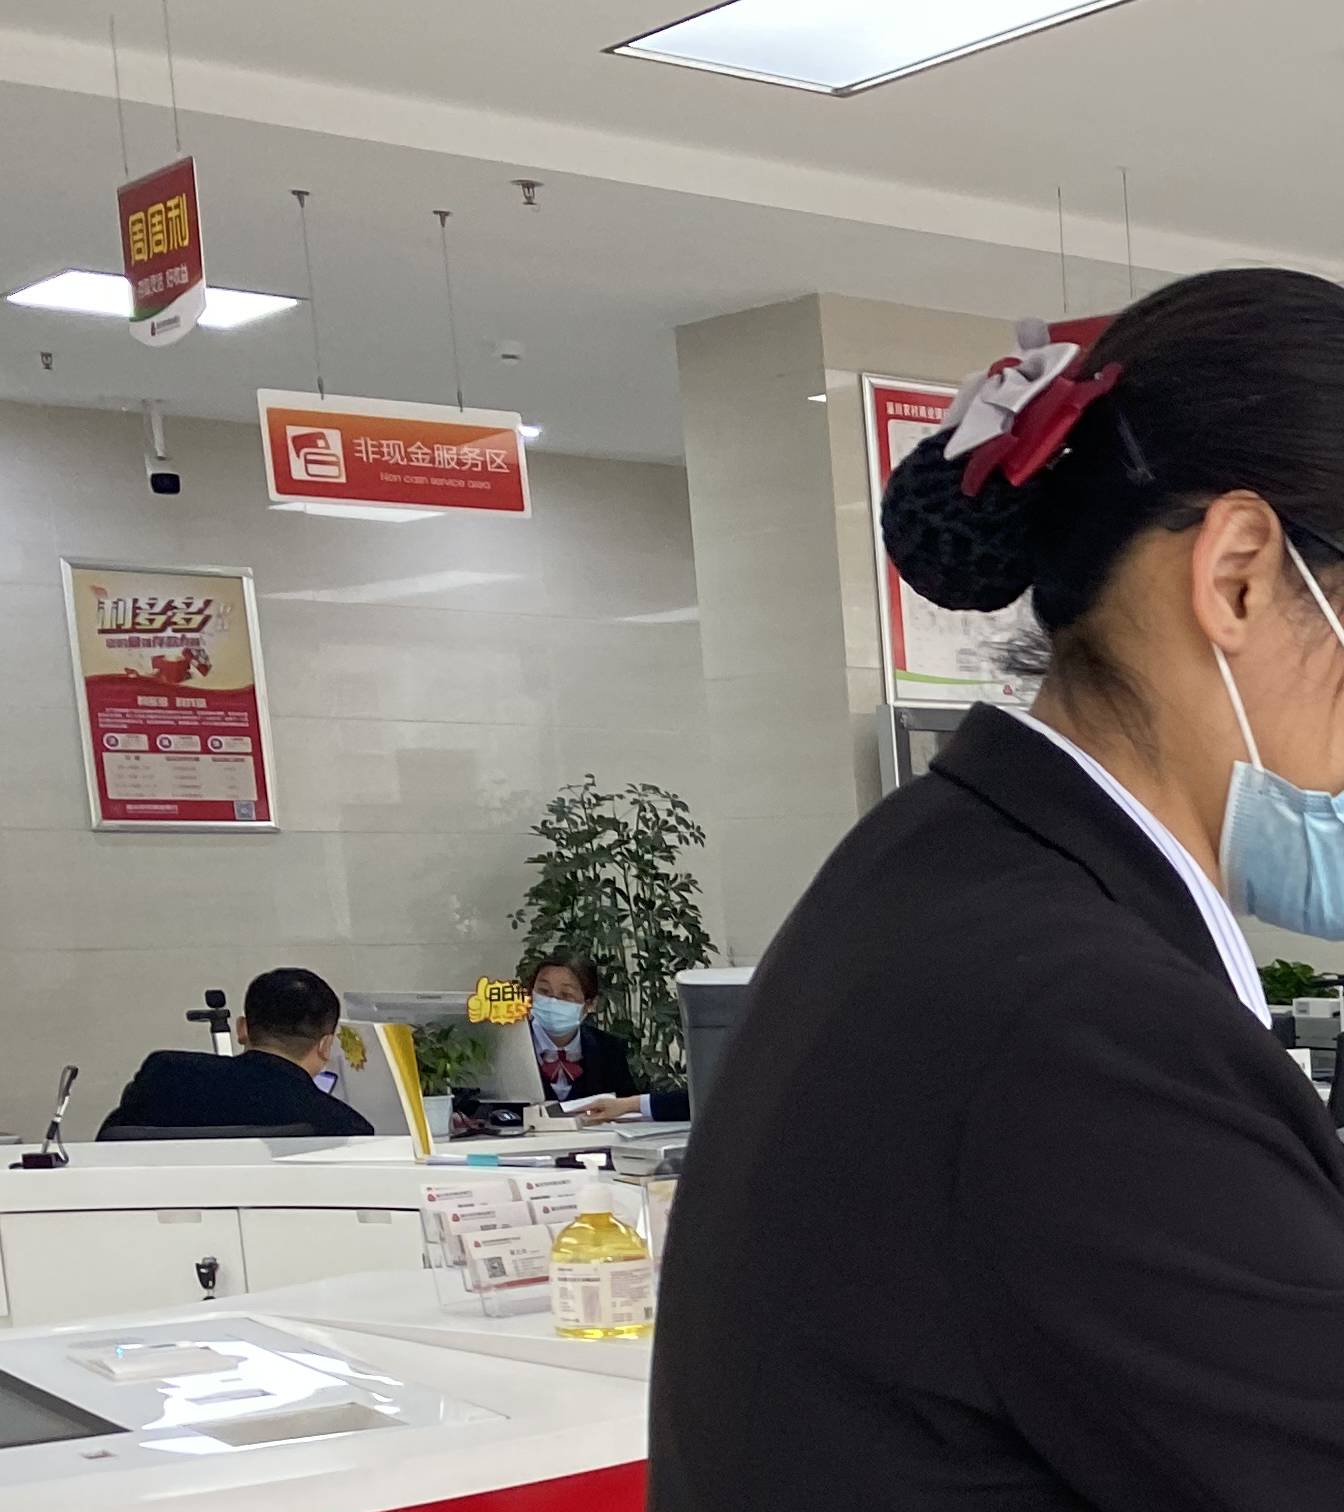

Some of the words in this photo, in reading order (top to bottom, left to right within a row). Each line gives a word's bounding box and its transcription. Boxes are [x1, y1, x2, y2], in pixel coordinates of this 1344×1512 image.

[129, 193, 190, 266] 周周利
[353, 436, 510, 473] 非现金服务区
[98, 597, 213, 634] 利多多
